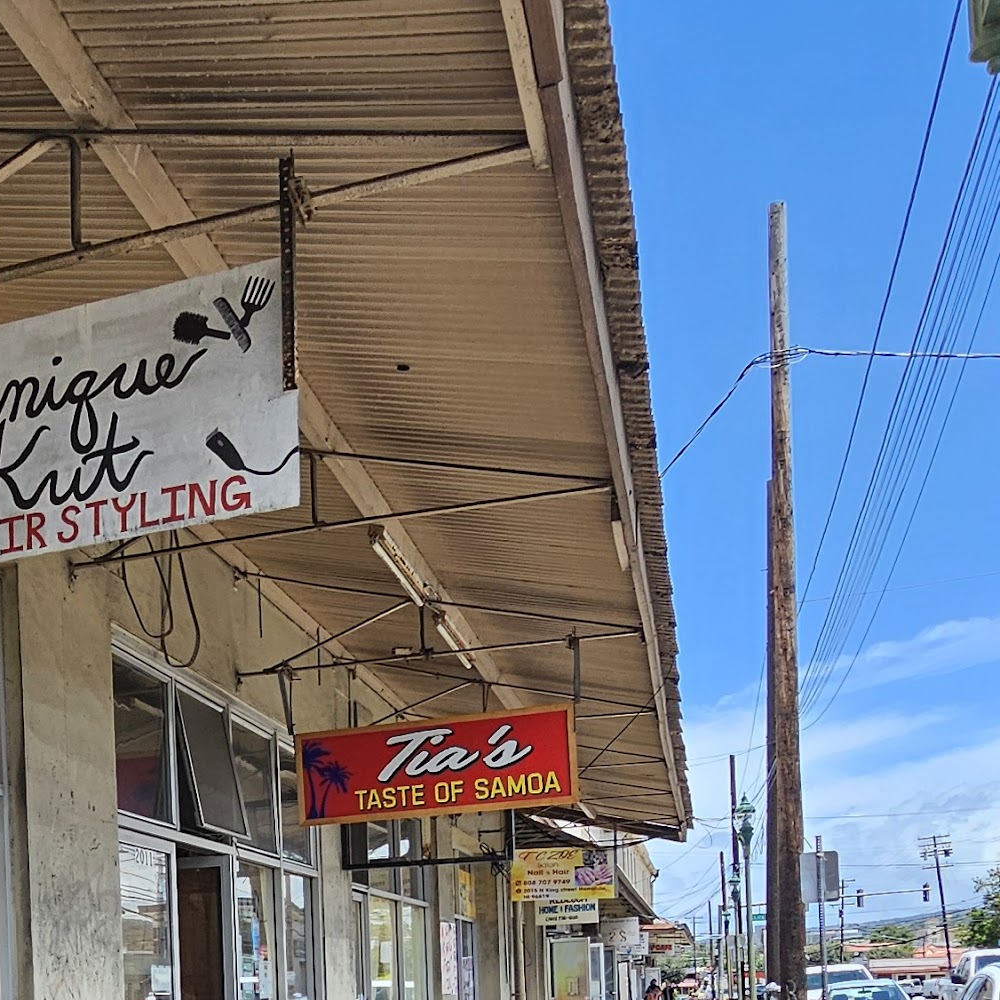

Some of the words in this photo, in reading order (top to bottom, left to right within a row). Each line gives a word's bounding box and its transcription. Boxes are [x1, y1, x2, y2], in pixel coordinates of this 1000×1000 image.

[377, 724, 532, 783] Tia's
[354, 783, 426, 811] TASTE
[434, 780, 464, 804] OF
[474, 771, 562, 800] SAMOA
[564, 903, 596, 913] FASHION
